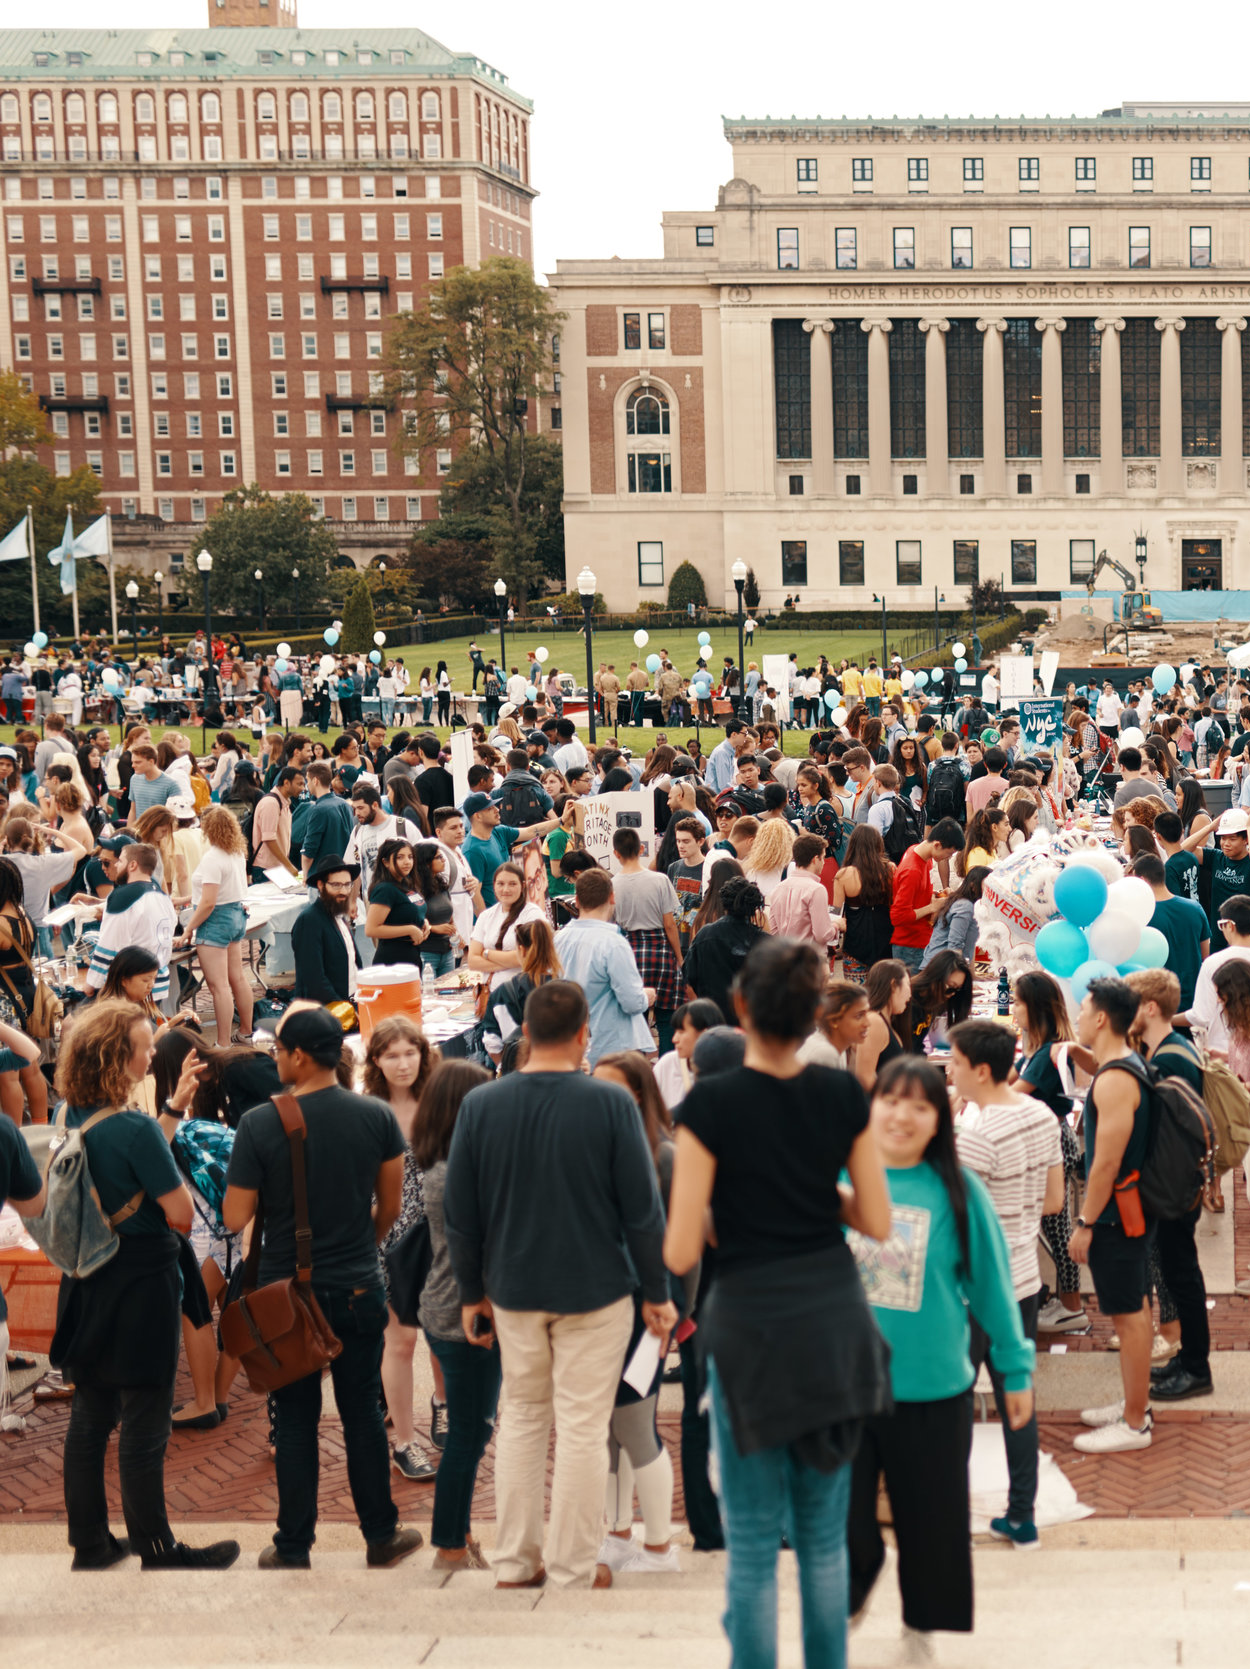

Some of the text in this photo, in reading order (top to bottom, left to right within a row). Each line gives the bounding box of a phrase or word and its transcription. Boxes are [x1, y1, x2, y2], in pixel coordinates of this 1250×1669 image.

[828, 288, 887, 299] HOMER
[900, 288, 1002, 299] HERODOTUS
[1016, 287, 1114, 299] SOPHOCLES
[1128, 287, 1184, 299] PLATO
